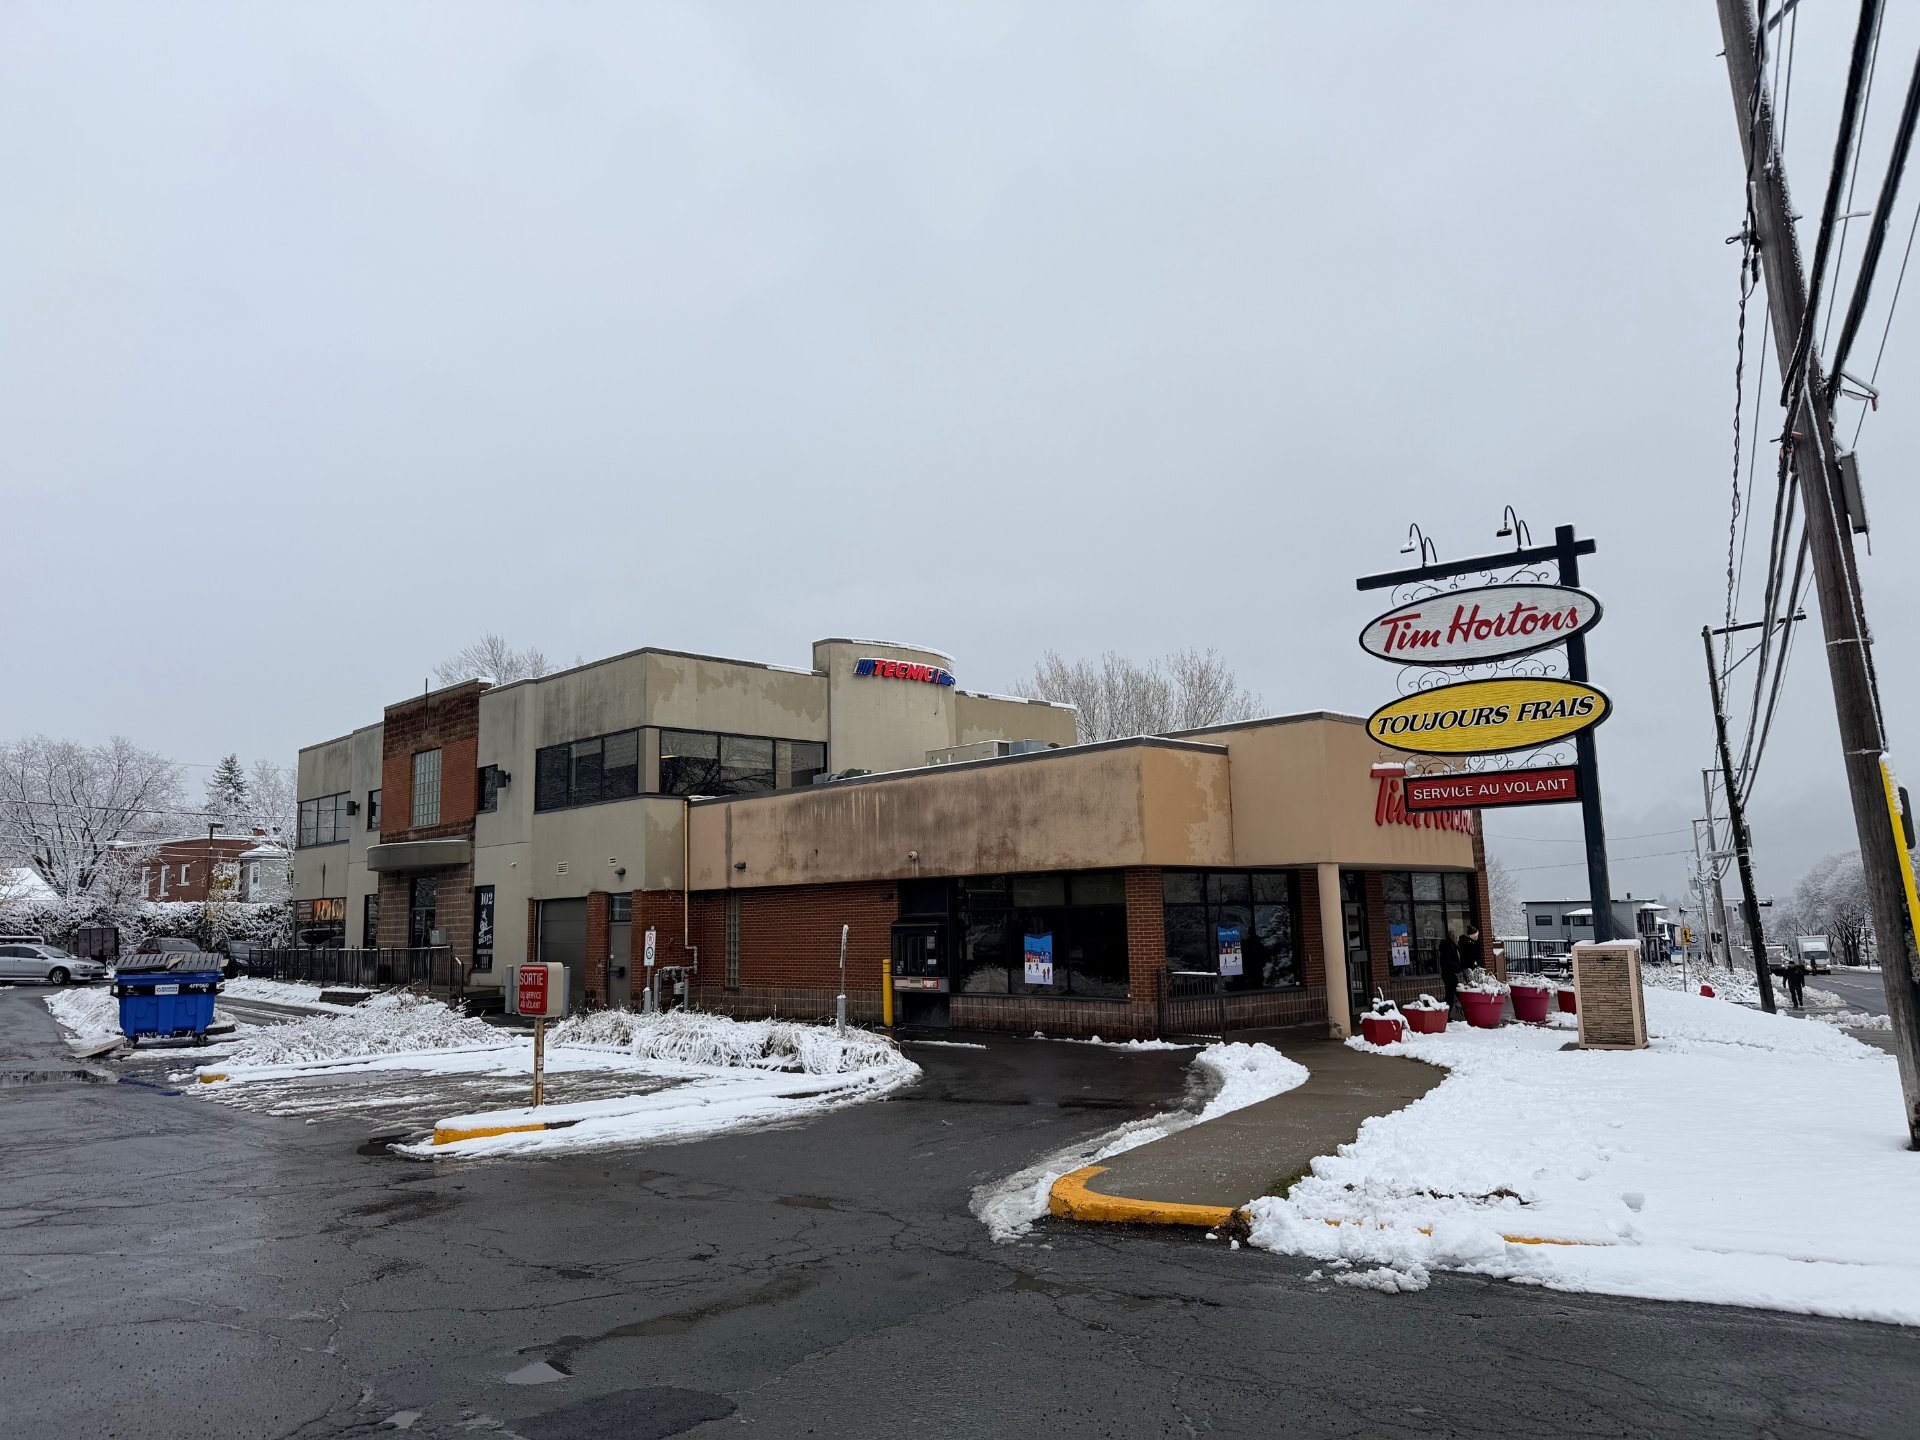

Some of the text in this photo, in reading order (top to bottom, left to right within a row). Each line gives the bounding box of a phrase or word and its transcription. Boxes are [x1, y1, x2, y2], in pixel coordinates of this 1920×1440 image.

[1380, 601, 1580, 654] Tim Hortons
[873, 659, 935, 682] TECNIC
[1376, 695, 1596, 736] TOUJOURS FRAIS
[1413, 778, 1569, 801] SERVICE AU VOLANT
[480, 892, 493, 906] 102
[519, 972, 544, 986] SORTIE
[526, 991, 542, 999] SERVICE
